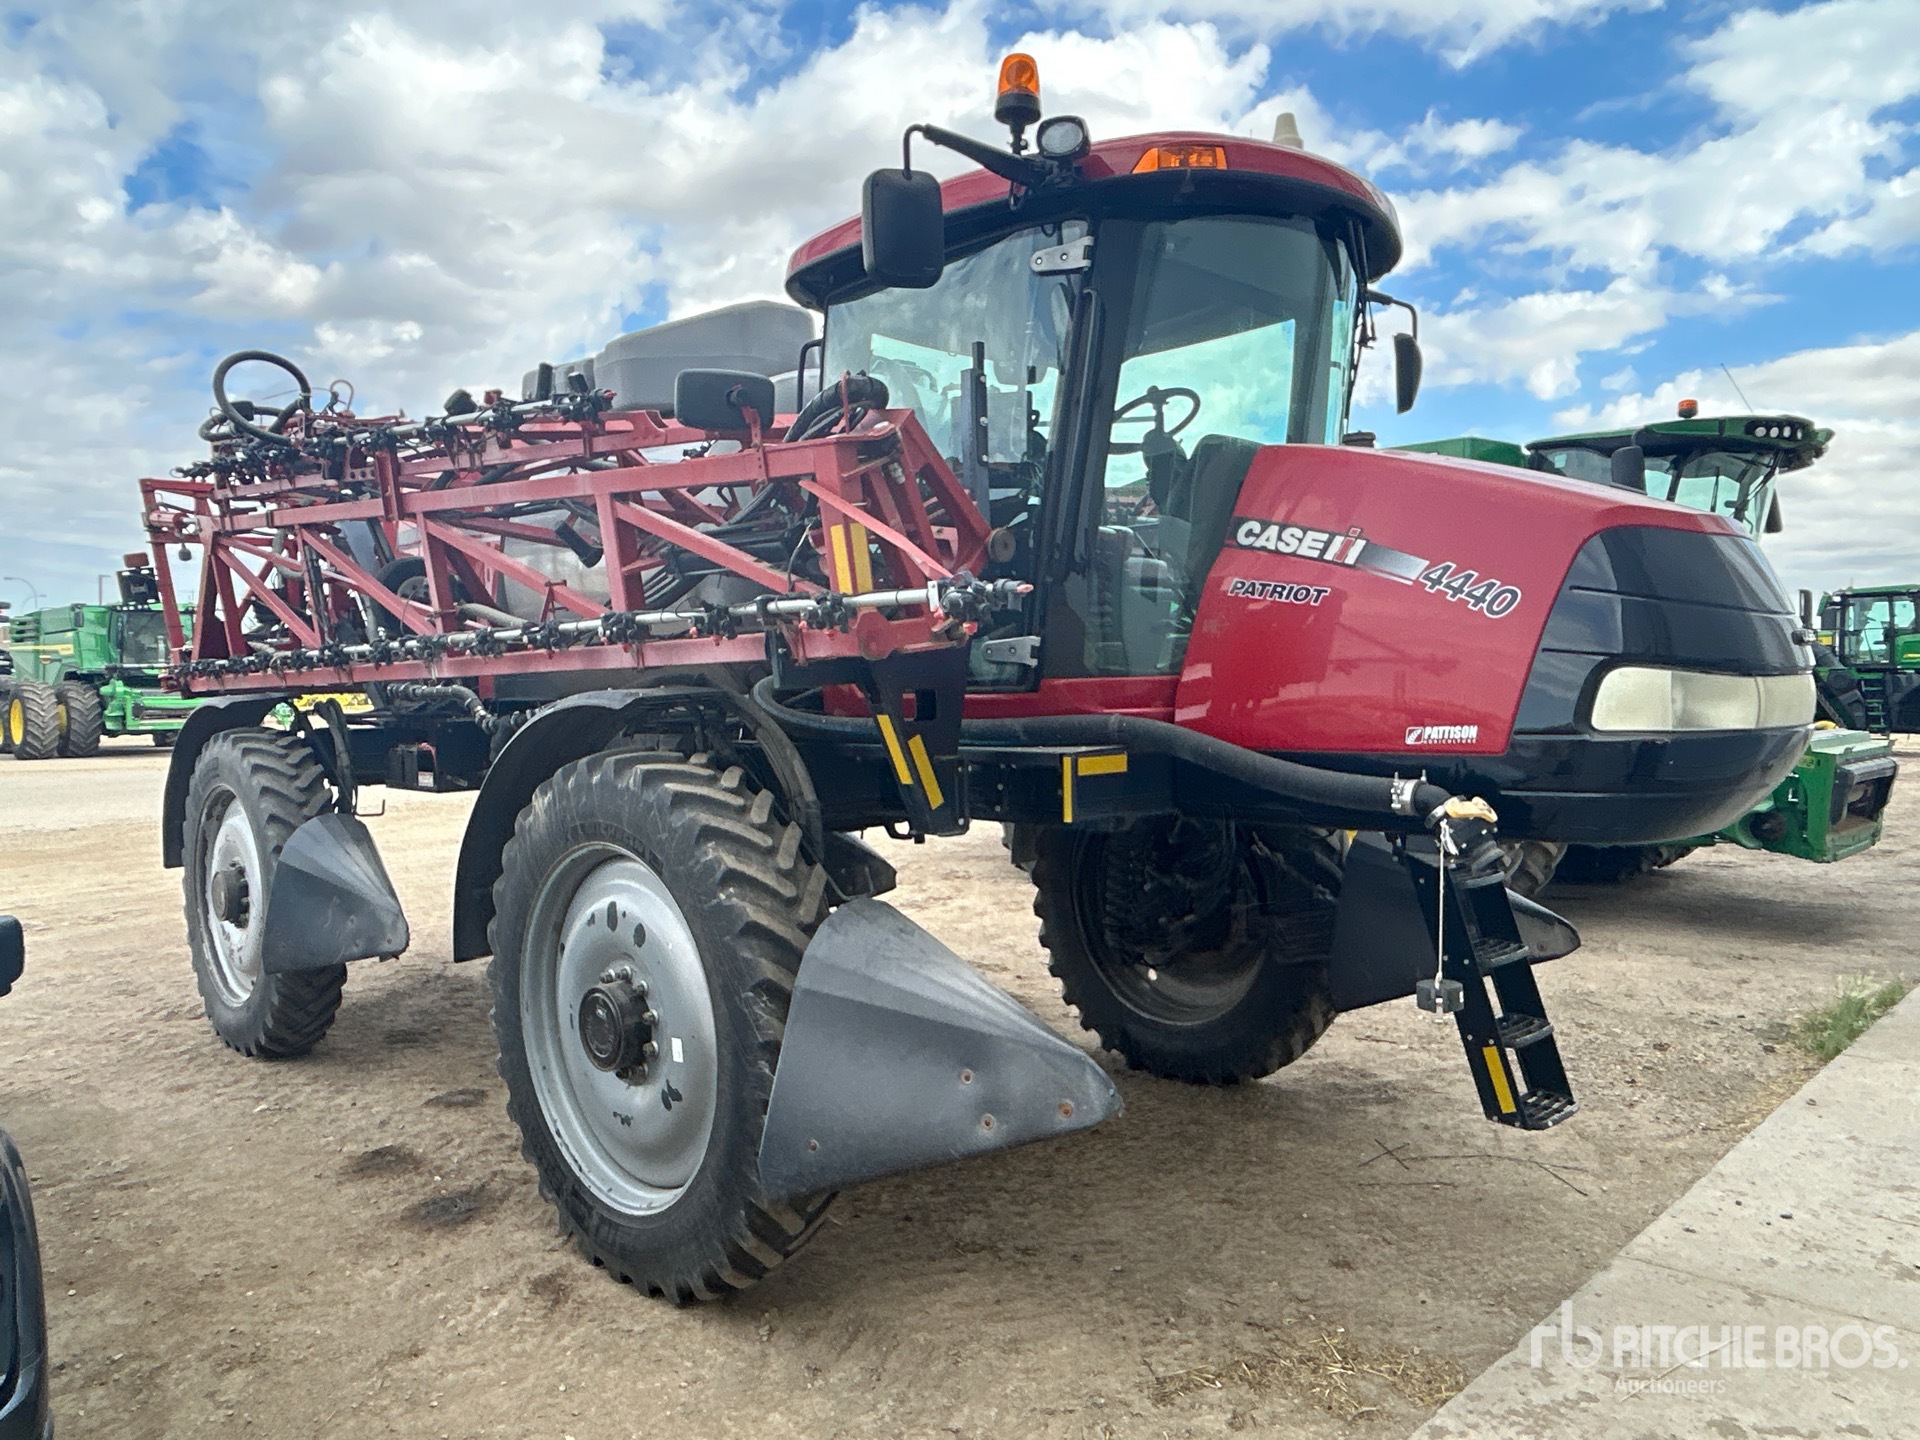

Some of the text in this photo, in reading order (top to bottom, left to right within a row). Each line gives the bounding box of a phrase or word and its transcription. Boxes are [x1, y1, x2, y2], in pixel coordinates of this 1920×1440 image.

[1228, 578, 1331, 606] PATRIOT
[1419, 561, 1521, 618] 4440
[1424, 725, 1478, 739] PATTISON
